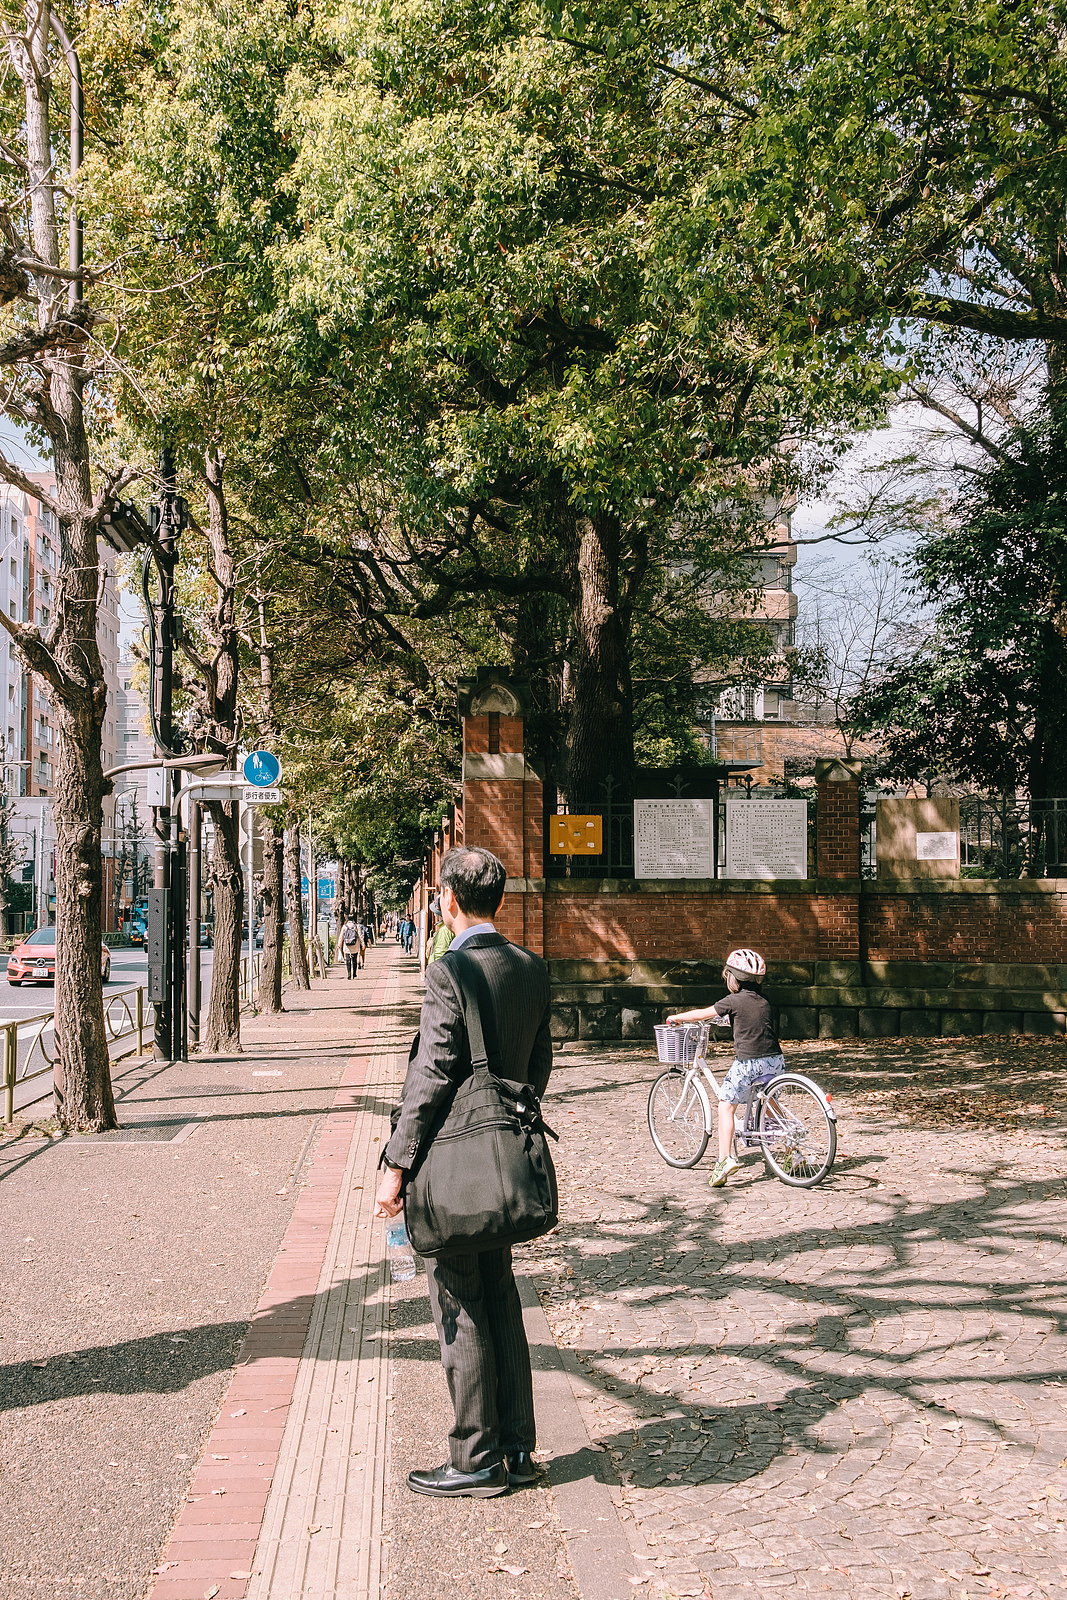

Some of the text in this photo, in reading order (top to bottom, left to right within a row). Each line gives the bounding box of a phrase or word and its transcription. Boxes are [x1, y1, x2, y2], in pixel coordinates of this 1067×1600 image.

[245, 792, 277, 800] 歩行者優先
